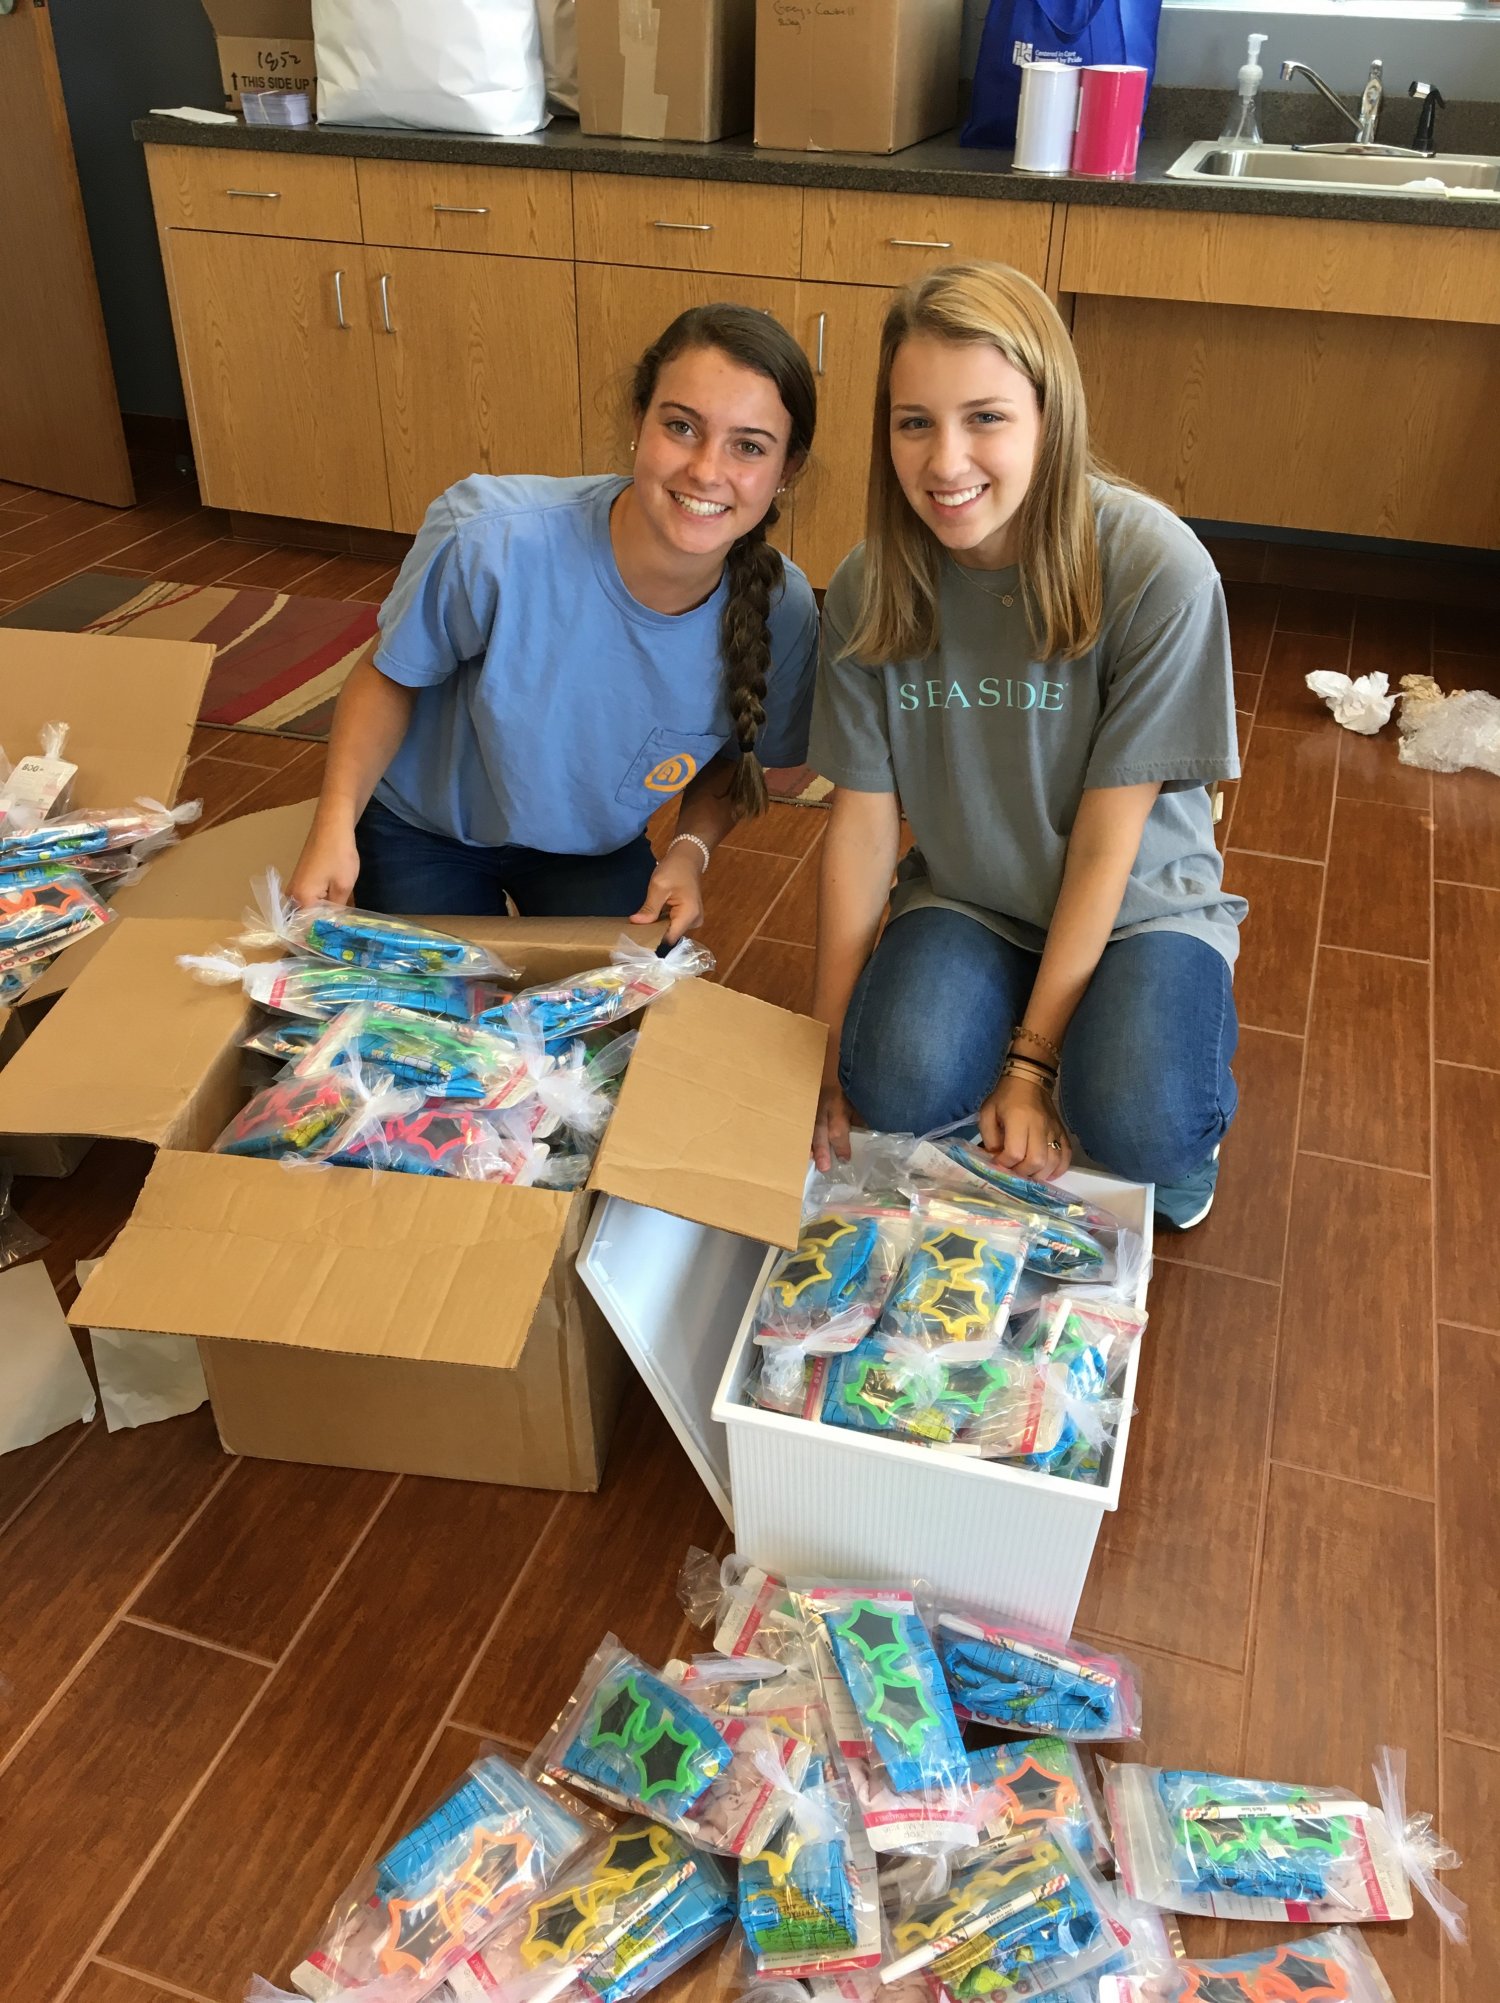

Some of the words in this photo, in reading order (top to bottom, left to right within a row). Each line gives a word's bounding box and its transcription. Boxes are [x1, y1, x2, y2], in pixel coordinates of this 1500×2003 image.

[241, 75, 266, 88] THIS
[267, 76, 293, 90] SIDE
[294, 78, 310, 90] UP
[900, 677, 1065, 711] SEASIDE
